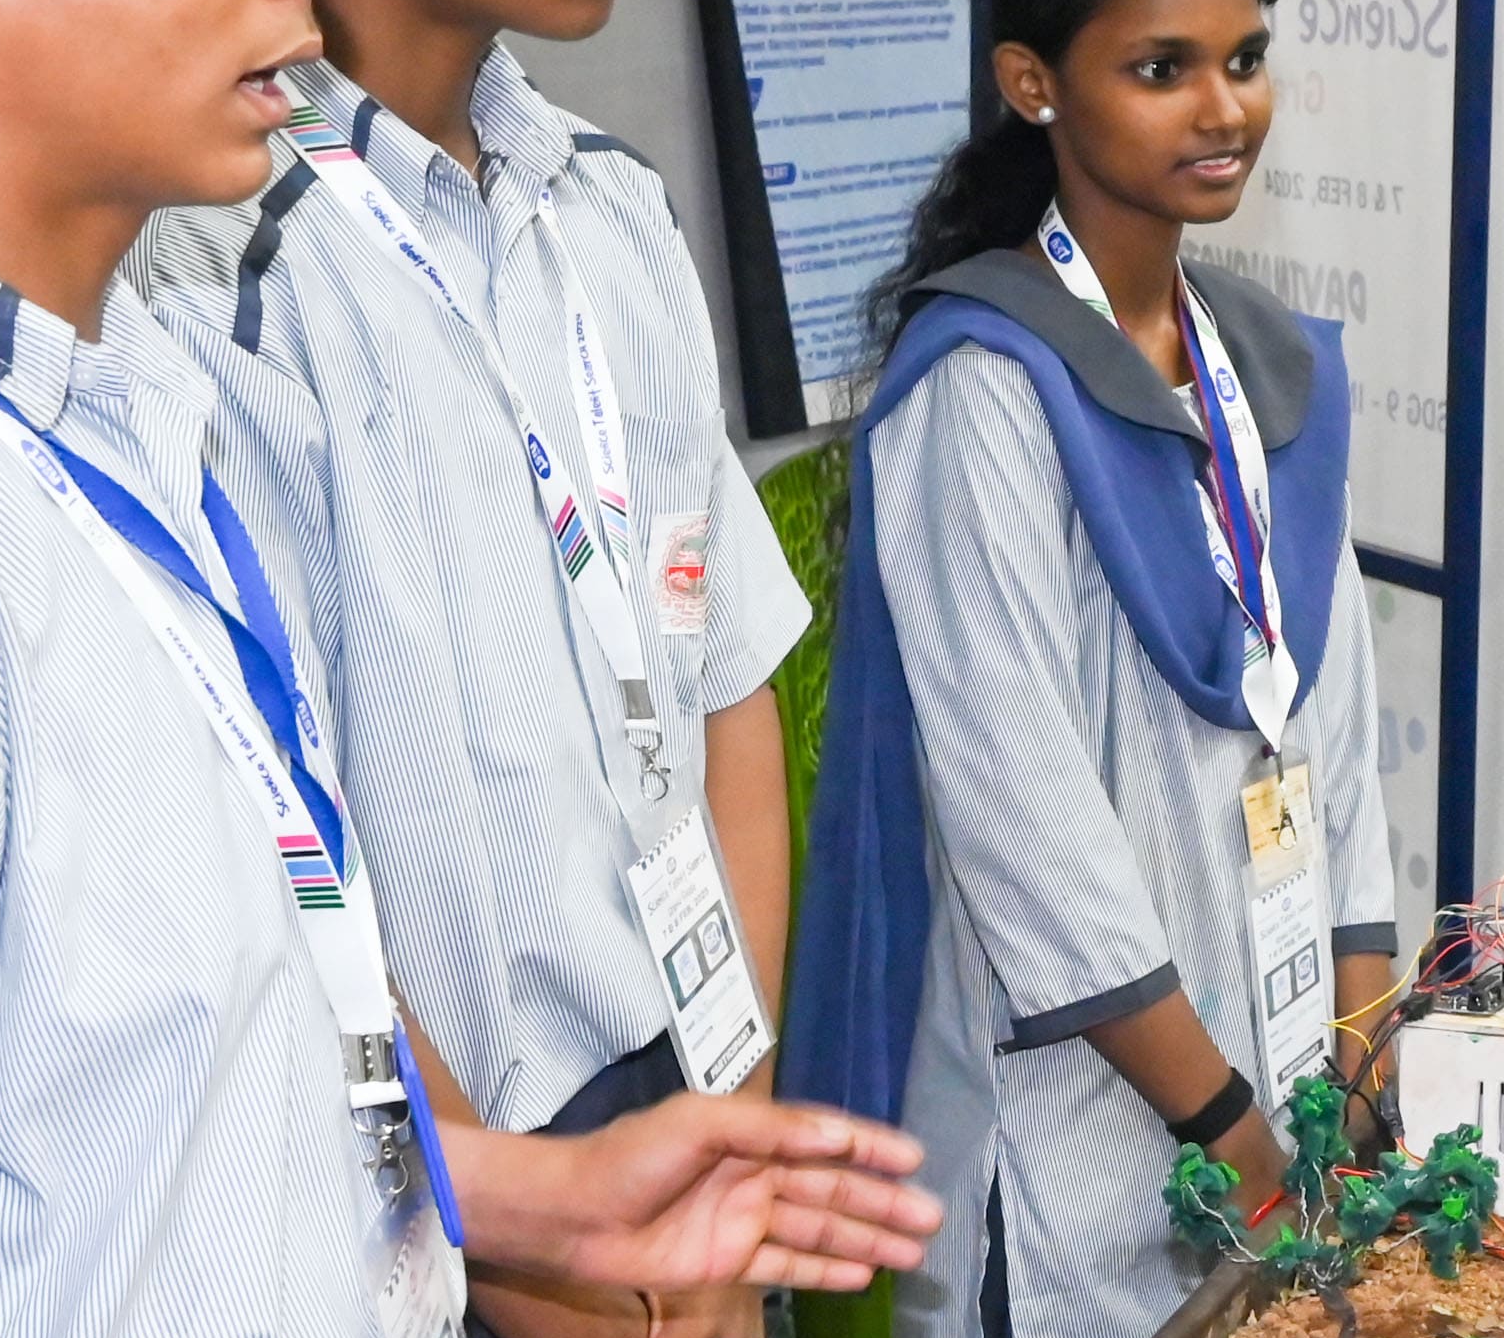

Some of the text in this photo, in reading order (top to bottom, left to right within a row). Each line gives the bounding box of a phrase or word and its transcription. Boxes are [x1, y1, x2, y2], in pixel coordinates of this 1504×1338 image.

[579, 345, 596, 387] Search
[598, 429, 615, 475] Science
[194, 665, 227, 715] Search
[226, 714, 258, 762] Talent
[257, 762, 291, 818] Science
